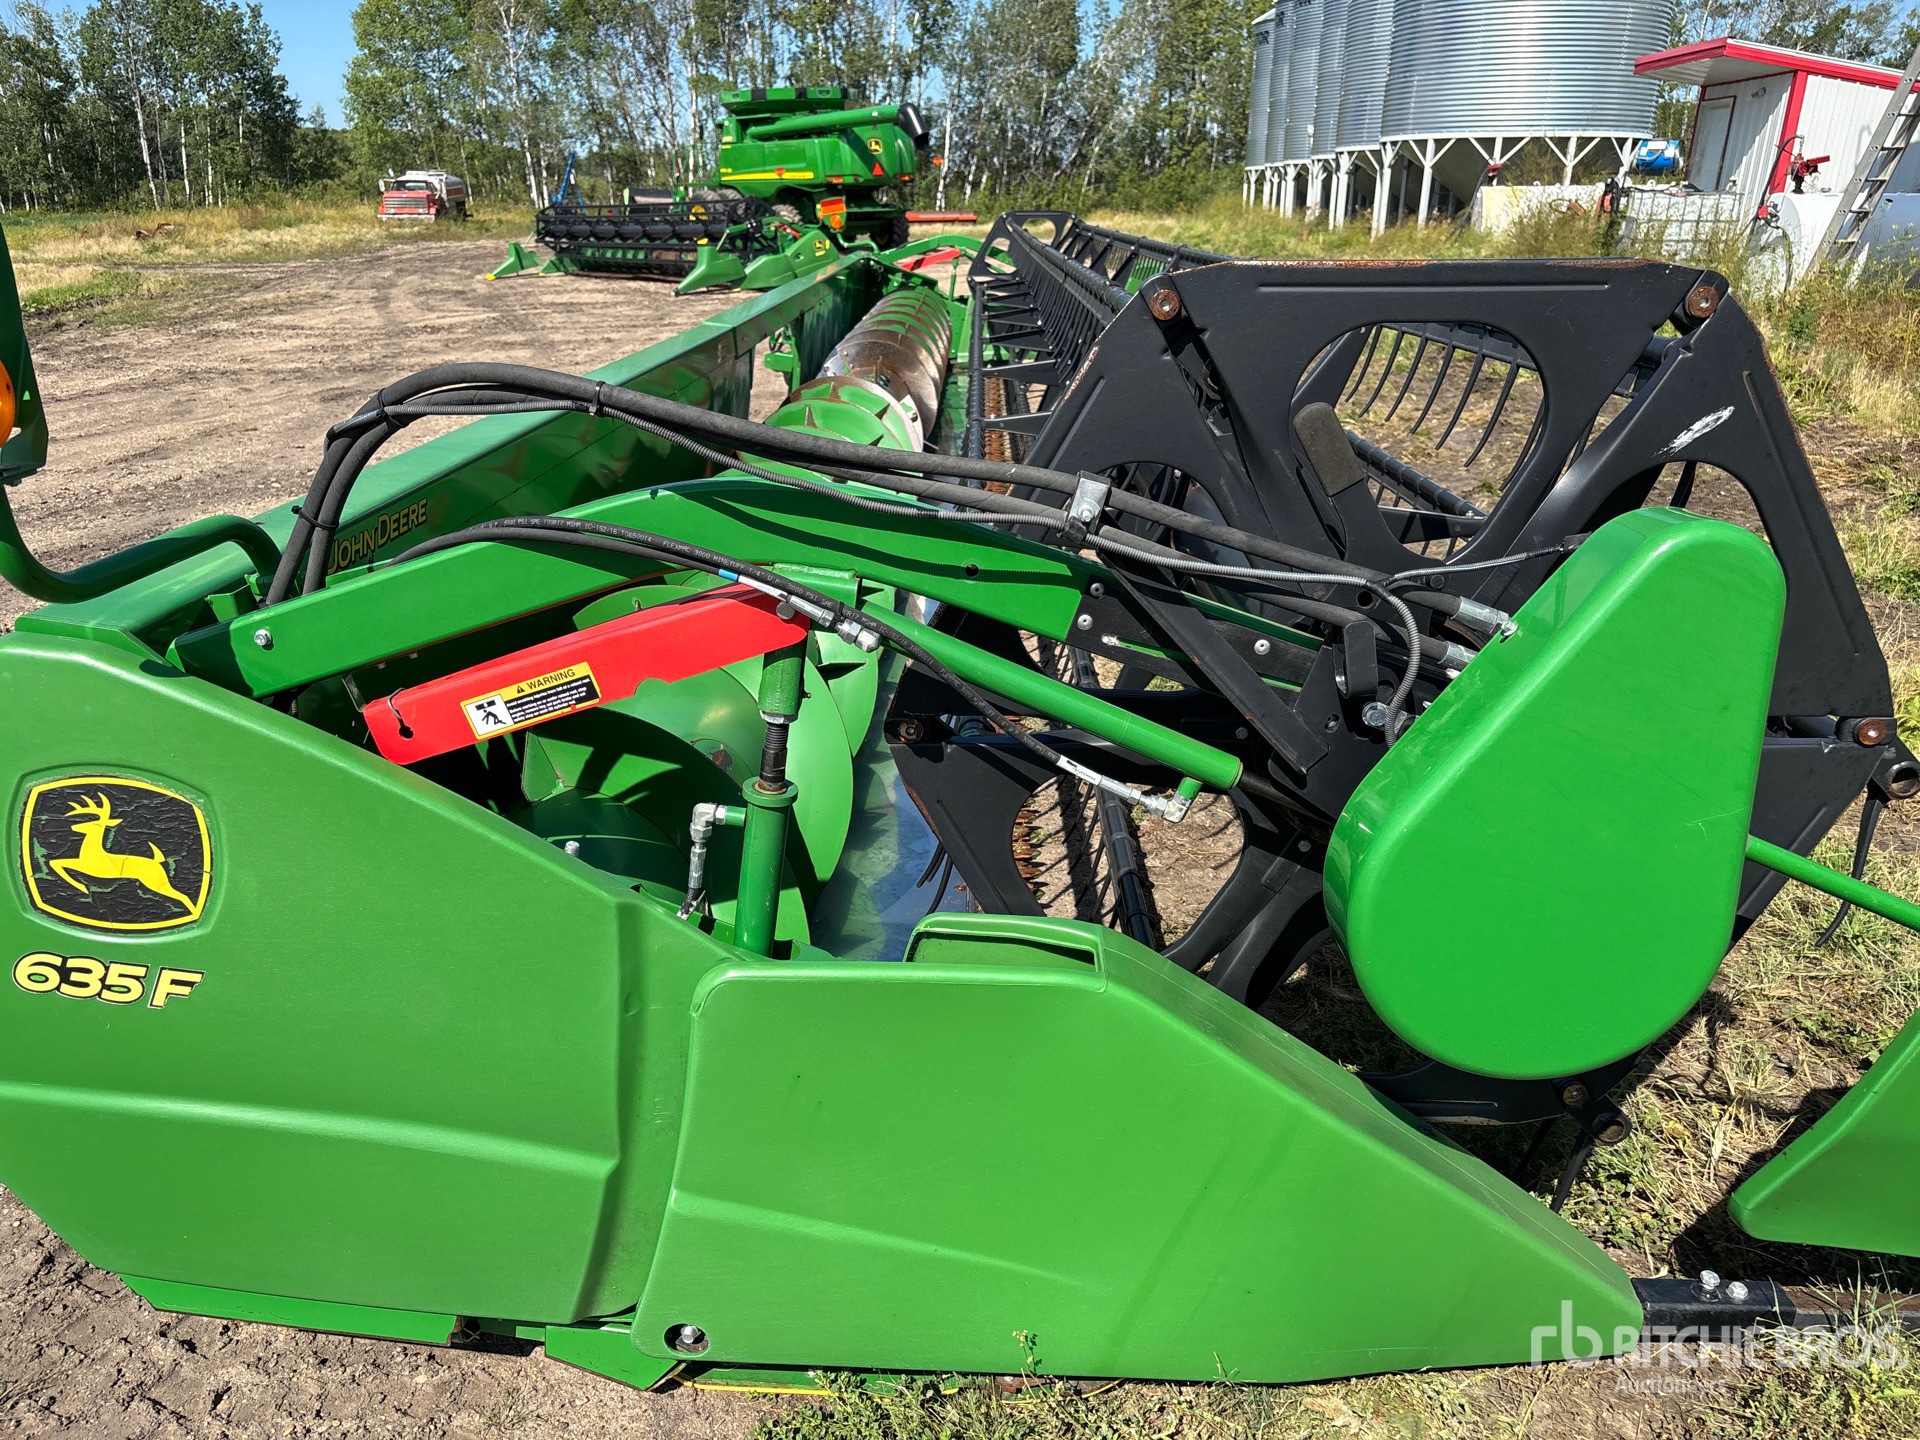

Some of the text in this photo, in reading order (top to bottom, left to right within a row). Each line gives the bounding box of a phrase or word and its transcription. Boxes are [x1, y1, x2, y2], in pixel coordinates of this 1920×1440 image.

[327, 498, 428, 575] JOHN DEERE
[693, 549, 711, 560] 3000
[786, 582, 804, 595] 3000
[804, 590, 818, 601] PSI
[820, 597, 834, 609] SAE
[526, 668, 576, 690] WARNING
